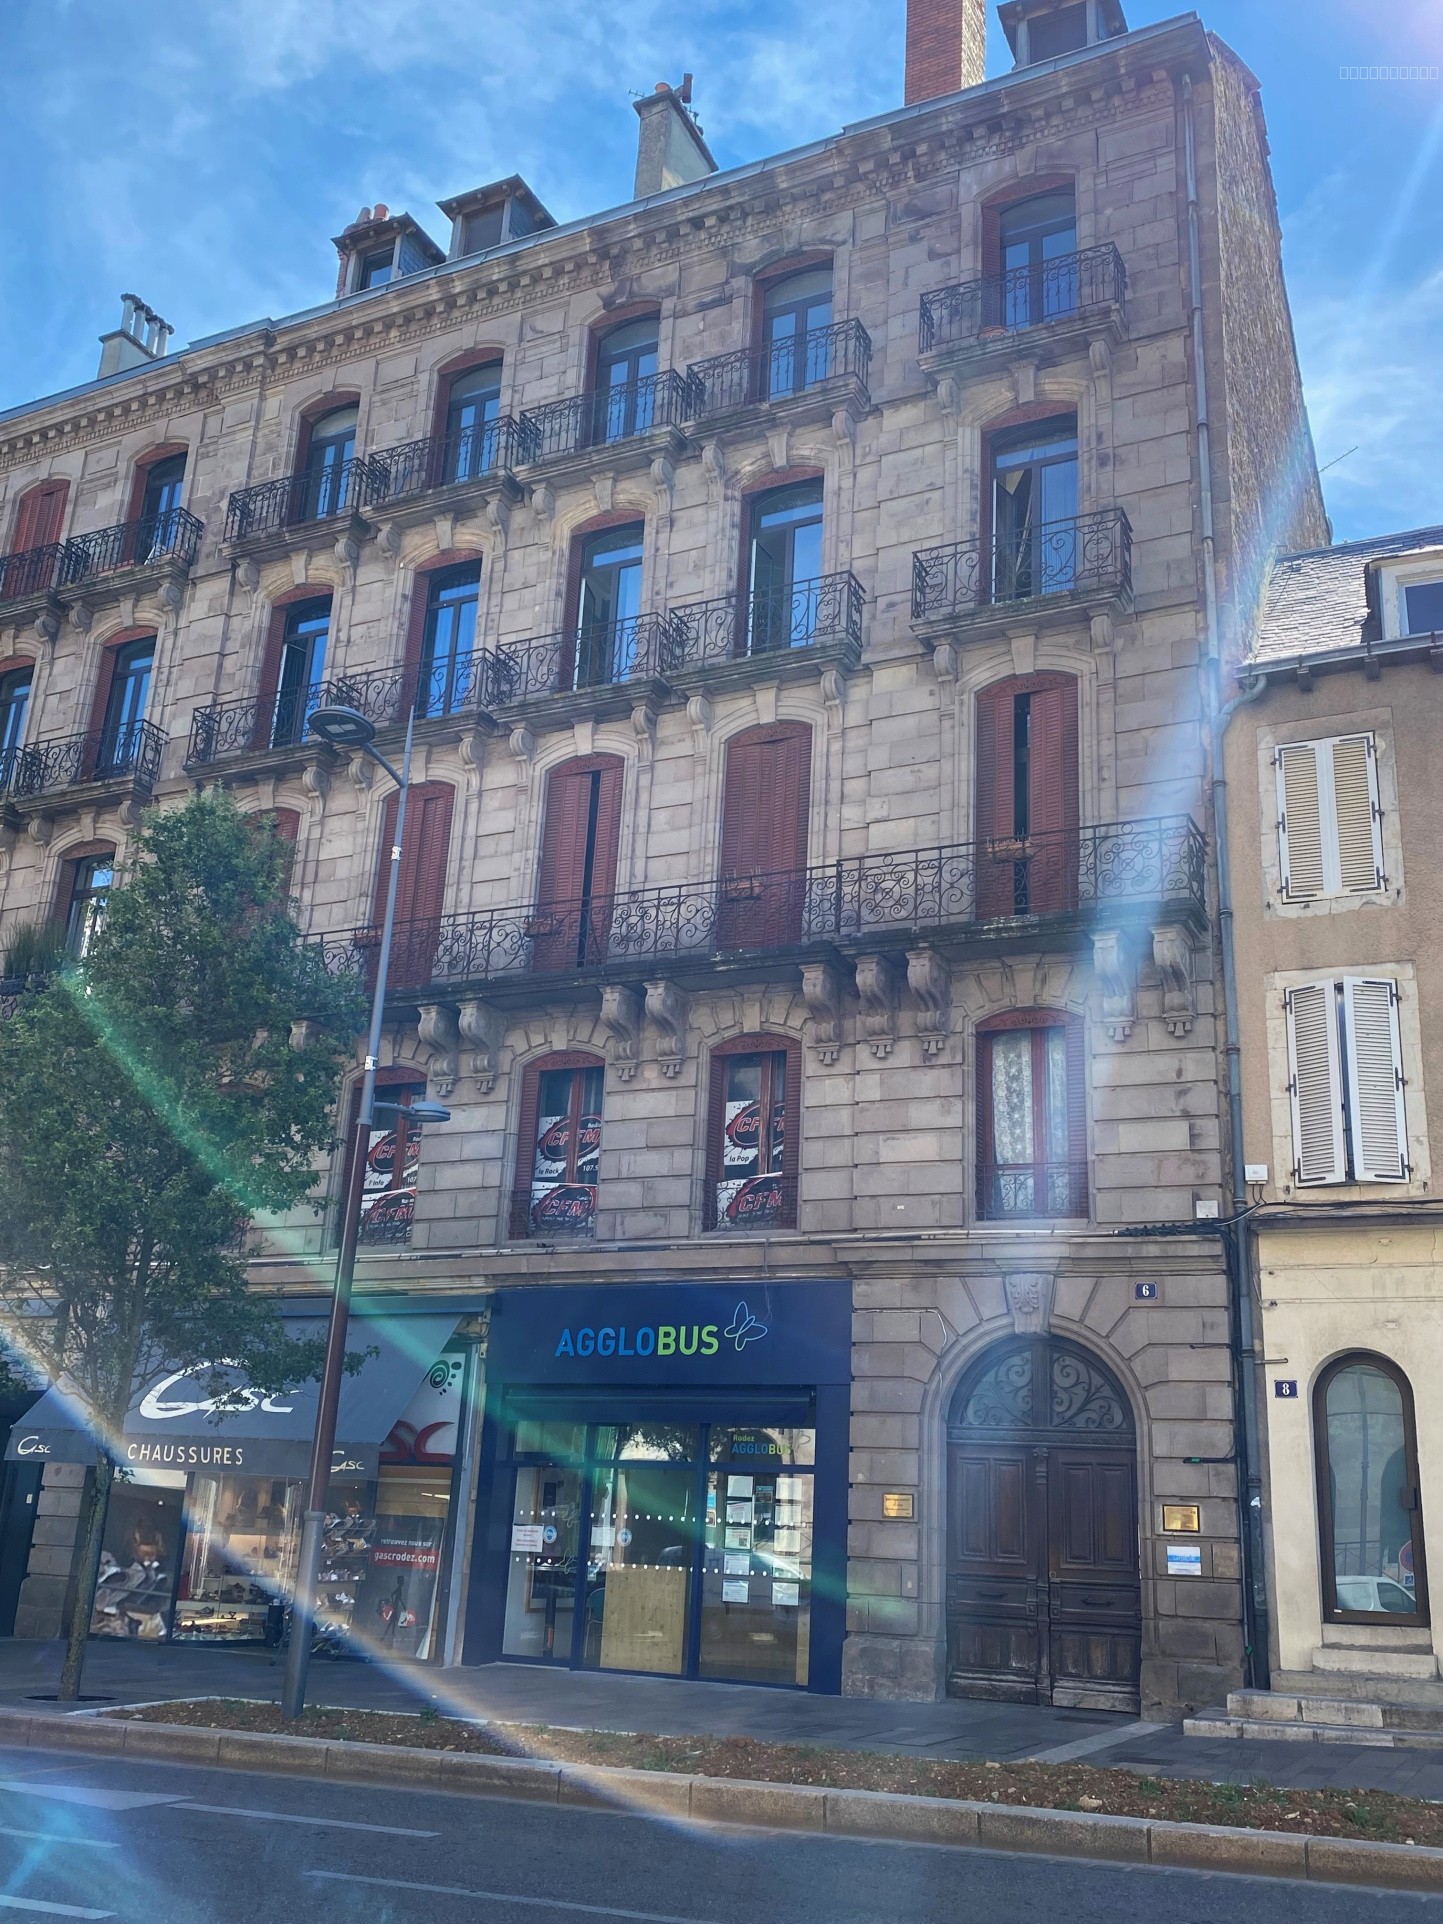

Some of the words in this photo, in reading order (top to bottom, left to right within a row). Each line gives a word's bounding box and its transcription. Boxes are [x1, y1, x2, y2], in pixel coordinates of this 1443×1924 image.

[541, 1199, 589, 1217] CFM
[1142, 1284, 1150, 1297] 6
[554, 1325, 719, 1357] AGGLOBUS
[1282, 1382, 1290, 1396] 8
[732, 1434, 755, 1442] Rodez
[127, 1443, 243, 1465] CHAUSSURES
[731, 1443, 791, 1455] AGGLOBUS
[380, 1538, 408, 1546] retrouvez
[374, 1551, 435, 1564] gascrodez.com
